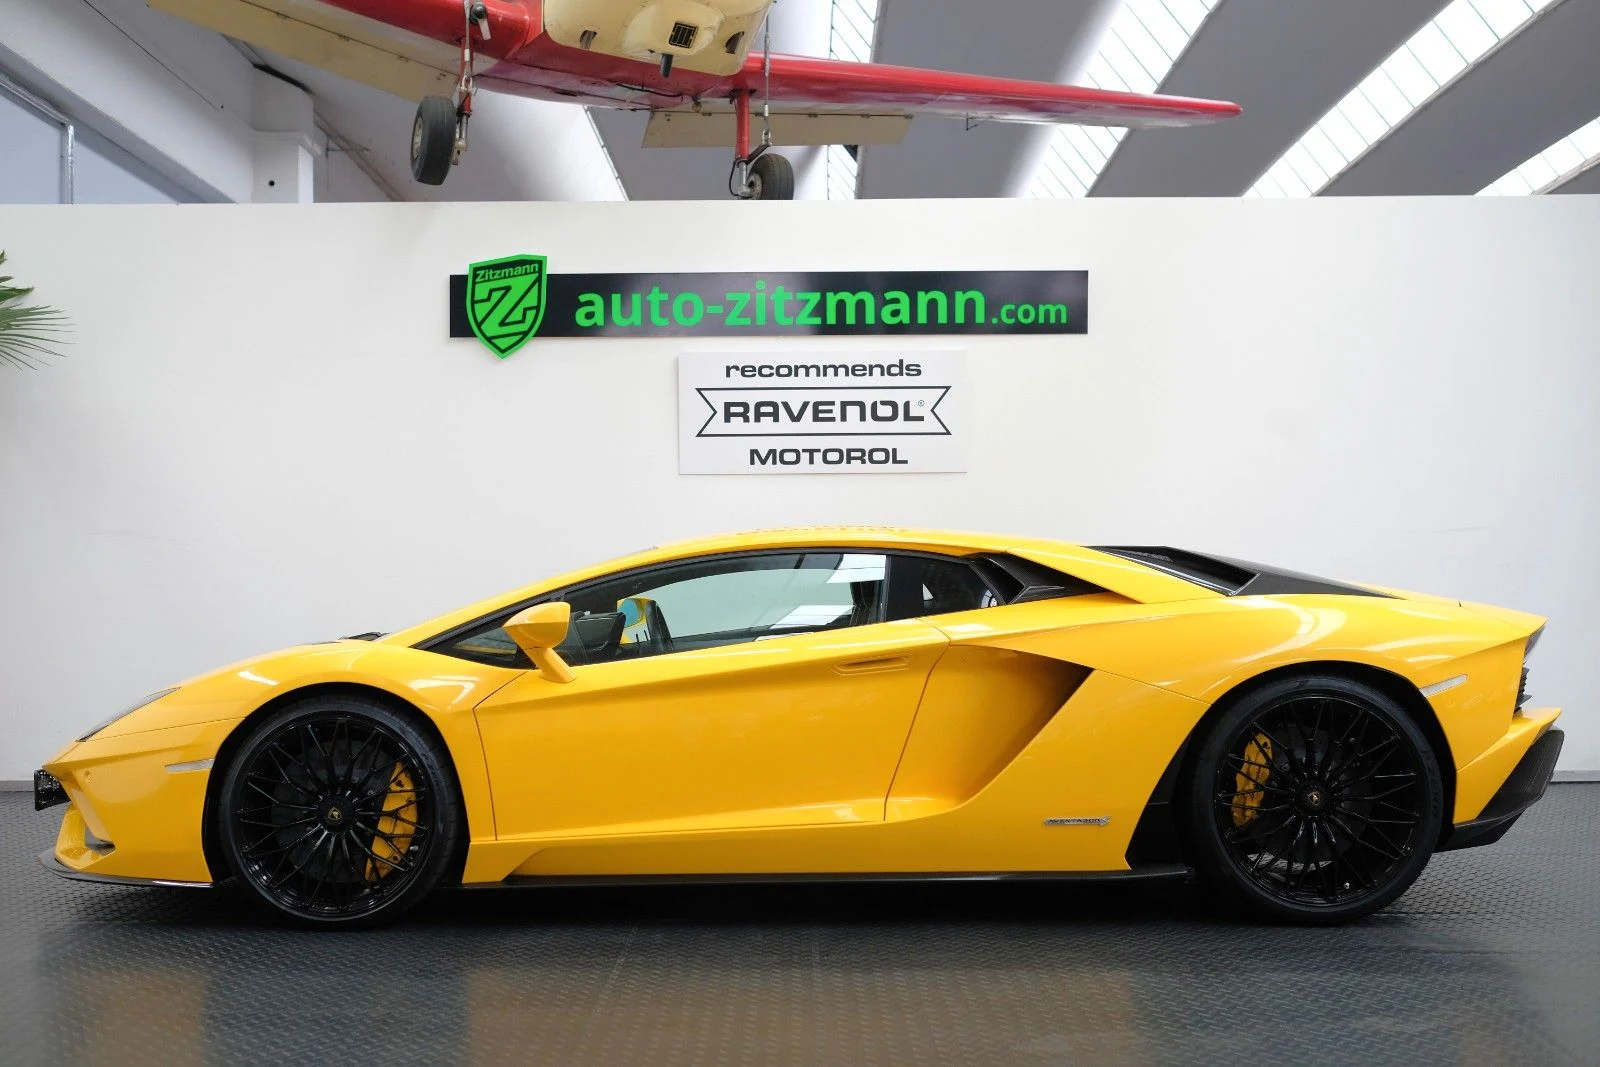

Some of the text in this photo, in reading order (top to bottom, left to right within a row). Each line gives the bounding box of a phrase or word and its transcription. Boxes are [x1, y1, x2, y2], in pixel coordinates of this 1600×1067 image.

[475, 263, 539, 282] Zitzmann
[575, 281, 1068, 327] auto-zitzmann.com
[726, 359, 921, 377] recommends
[750, 448, 908, 465] MOTOROL
